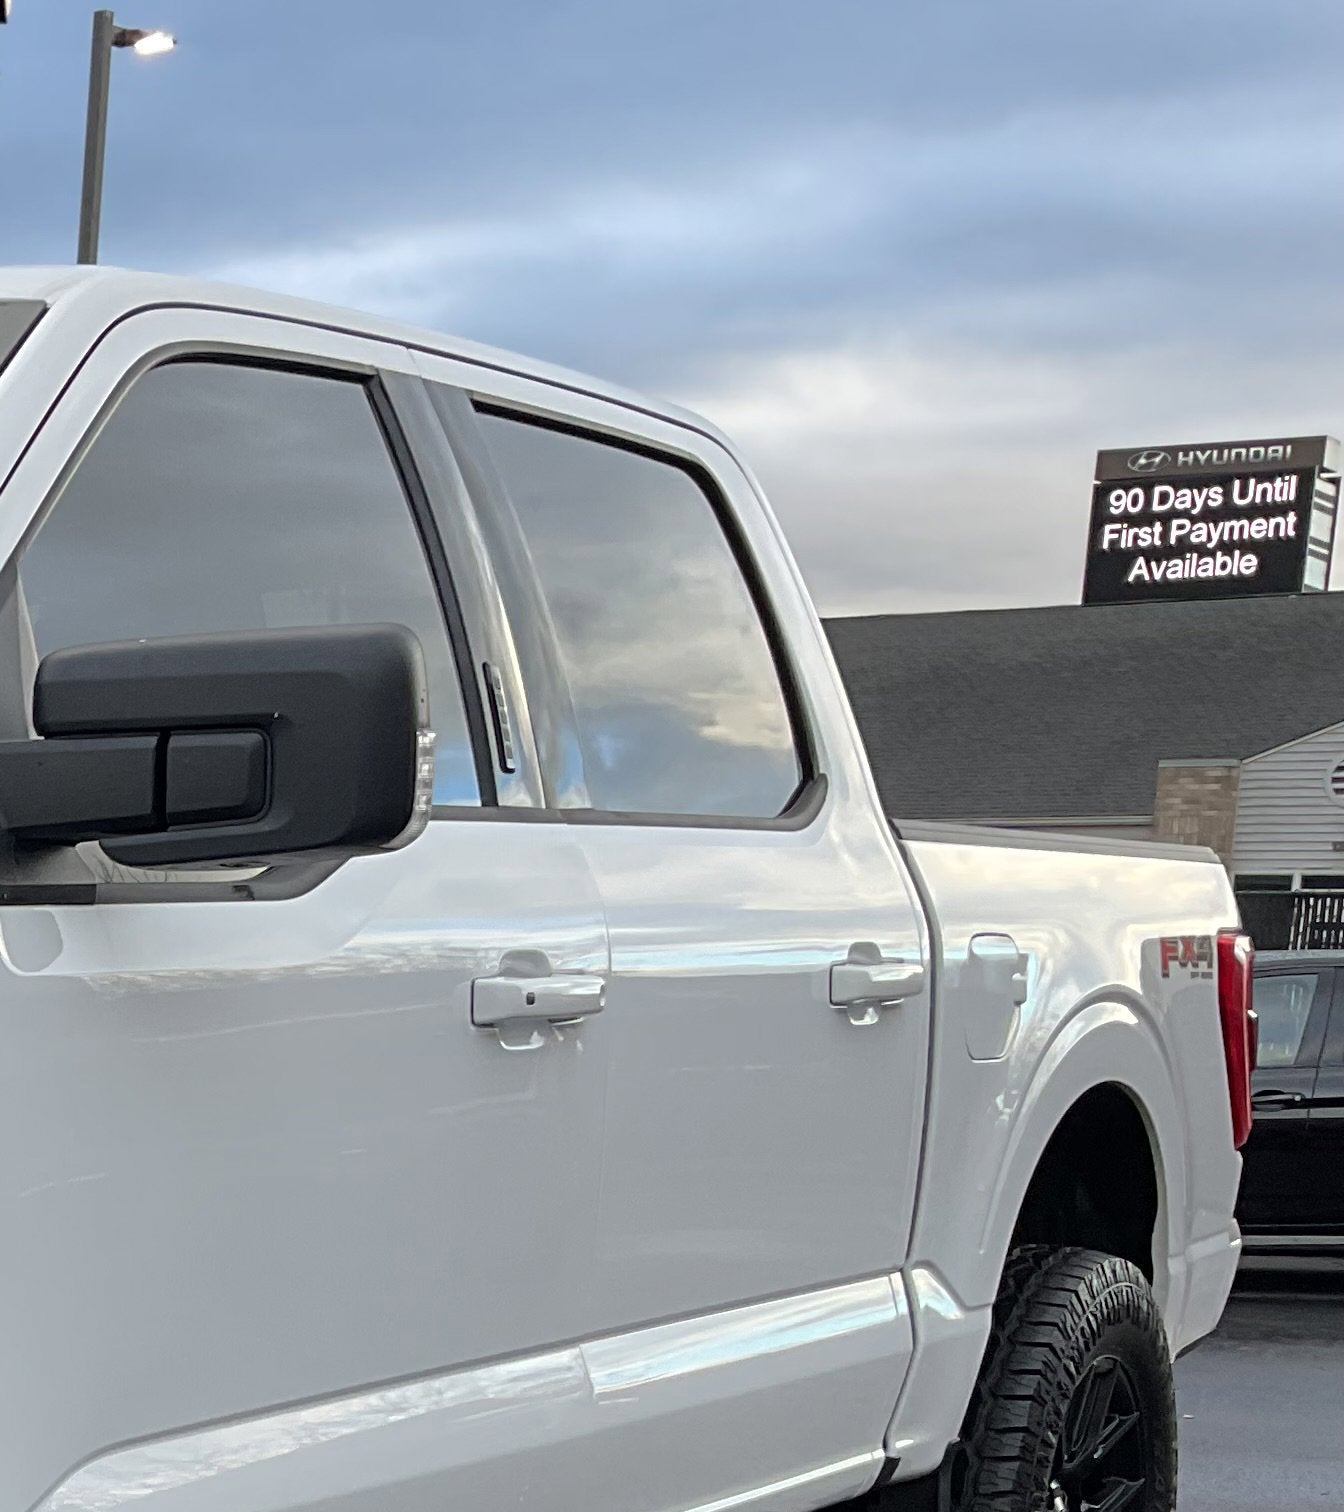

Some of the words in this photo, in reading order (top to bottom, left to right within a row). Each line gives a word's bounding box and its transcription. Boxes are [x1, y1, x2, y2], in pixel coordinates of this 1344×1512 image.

[1177, 445, 1292, 467] HYUNDAI
[1109, 487, 1145, 515] 90
[1152, 485, 1223, 514] Days
[1232, 475, 1299, 506] Until
[1102, 522, 1163, 550] First
[1169, 511, 1297, 548] Payment
[1127, 549, 1259, 584] Available
